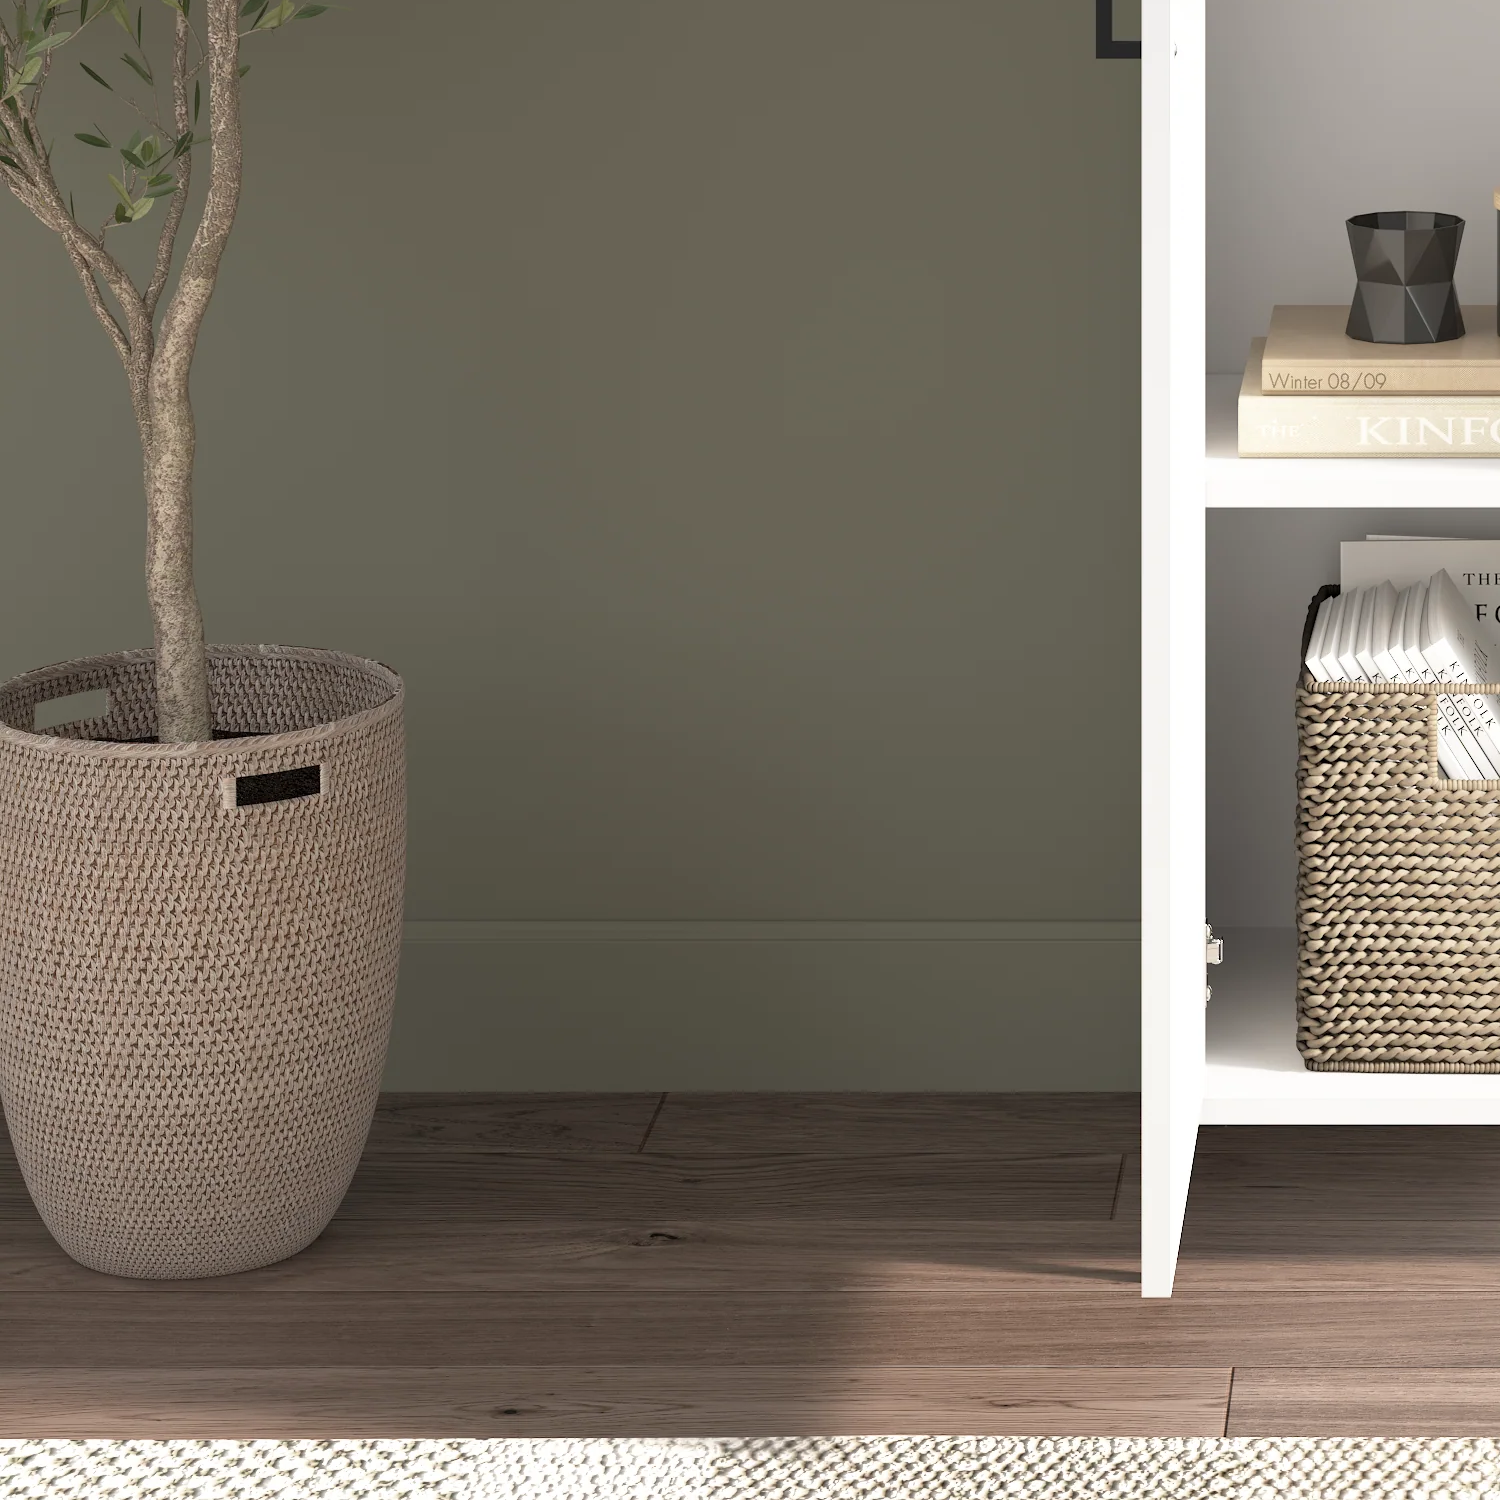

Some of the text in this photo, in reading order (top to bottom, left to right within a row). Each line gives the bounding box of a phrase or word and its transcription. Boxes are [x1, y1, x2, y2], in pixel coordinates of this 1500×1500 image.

[1268, 372, 1387, 392] Winter 08/09
[1258, 424, 1300, 438] THE
